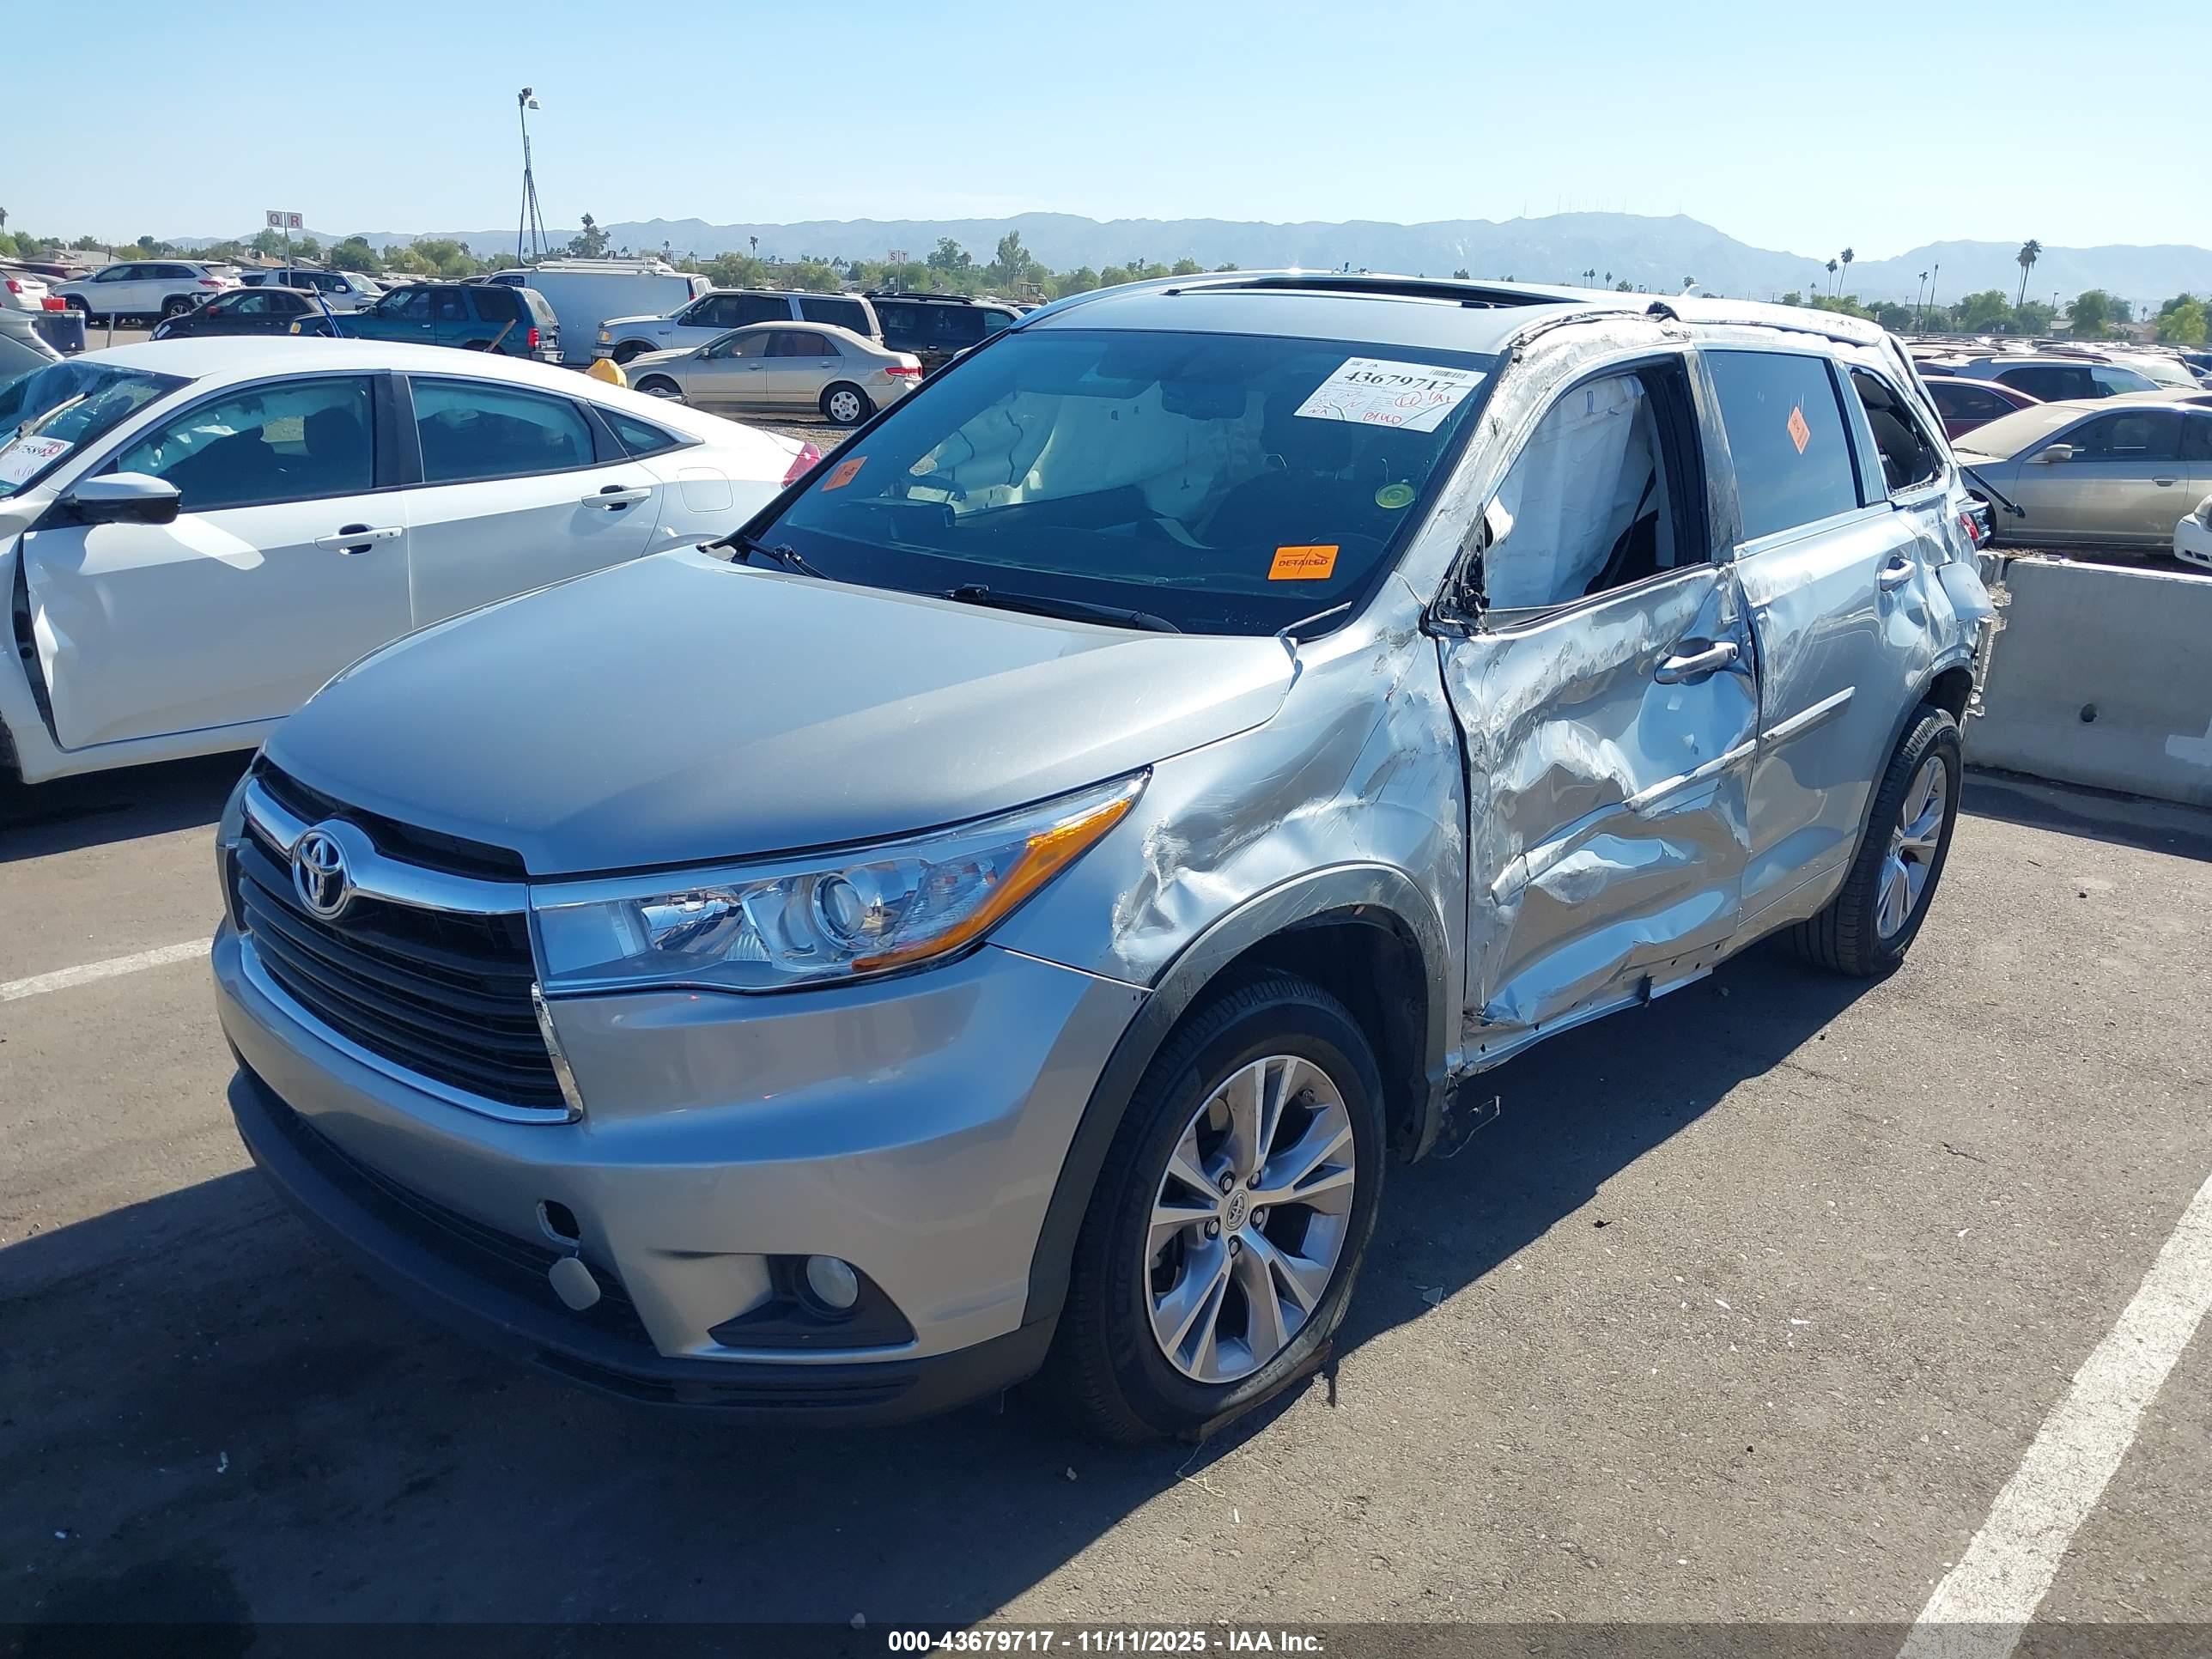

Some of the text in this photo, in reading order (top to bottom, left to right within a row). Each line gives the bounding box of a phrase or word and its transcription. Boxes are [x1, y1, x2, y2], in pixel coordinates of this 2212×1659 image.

[270, 214, 300, 227] Q R
[890, 252, 908, 262] S T
[1344, 371, 1456, 392] 43679717
[1278, 558, 1328, 567] DETAILED
